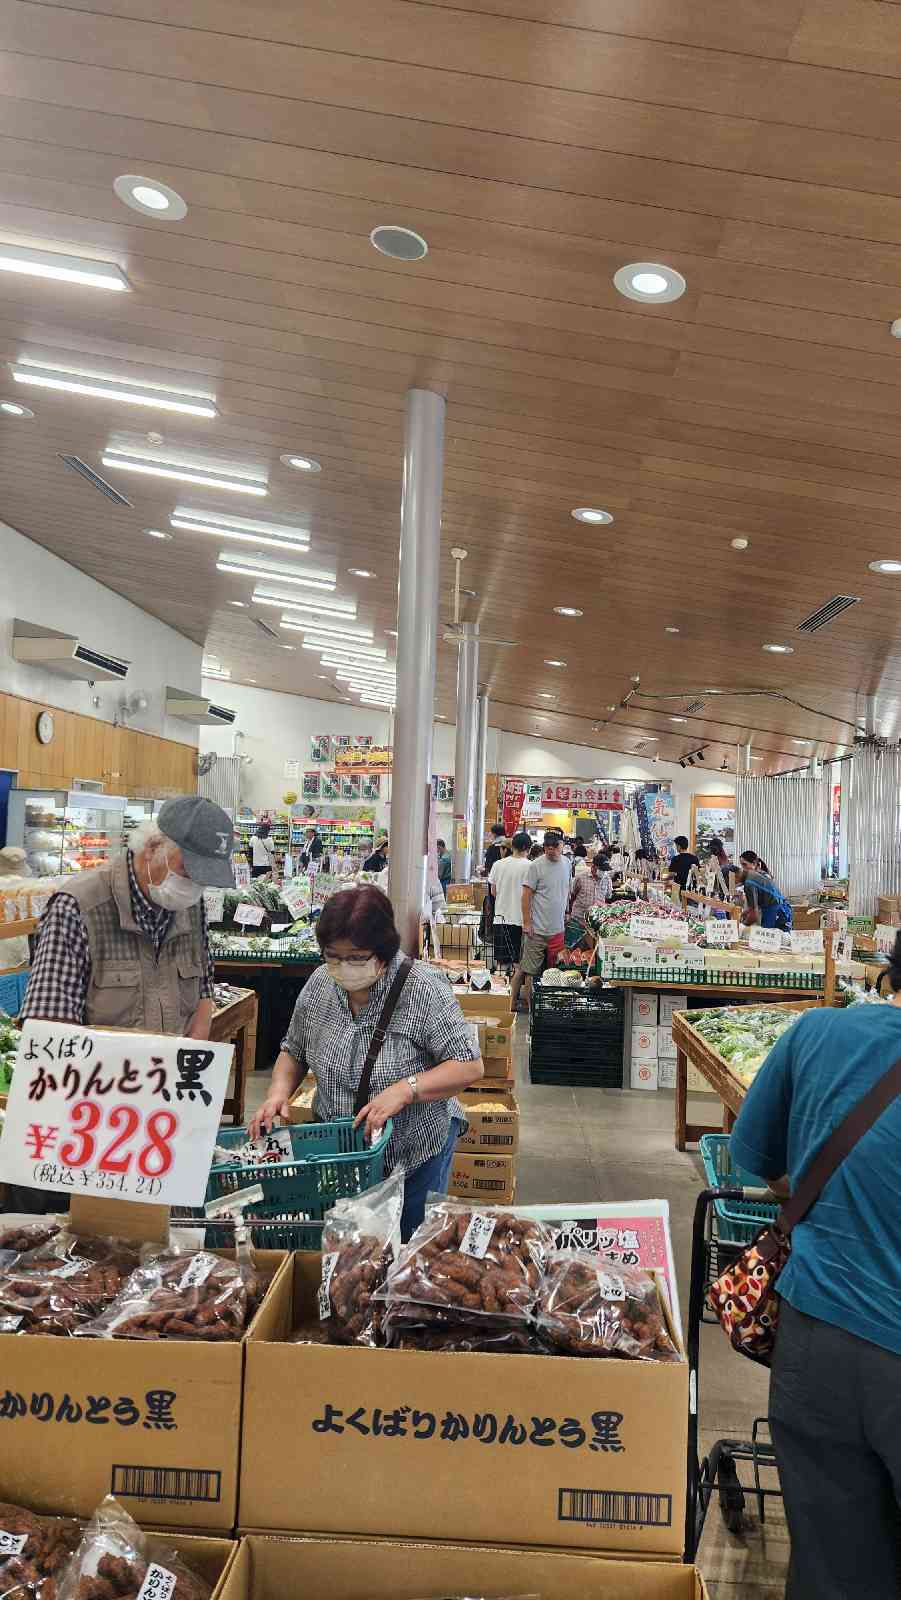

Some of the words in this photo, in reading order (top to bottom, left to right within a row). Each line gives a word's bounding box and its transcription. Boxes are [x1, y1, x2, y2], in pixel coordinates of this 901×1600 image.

[23, 1035, 95, 1061] よくばり
[28, 1047, 215, 1107] かりんとう黒
[24, 1100, 180, 1178] ¥328
[311, 1404, 625, 1454] よくばりかりんとう黒
